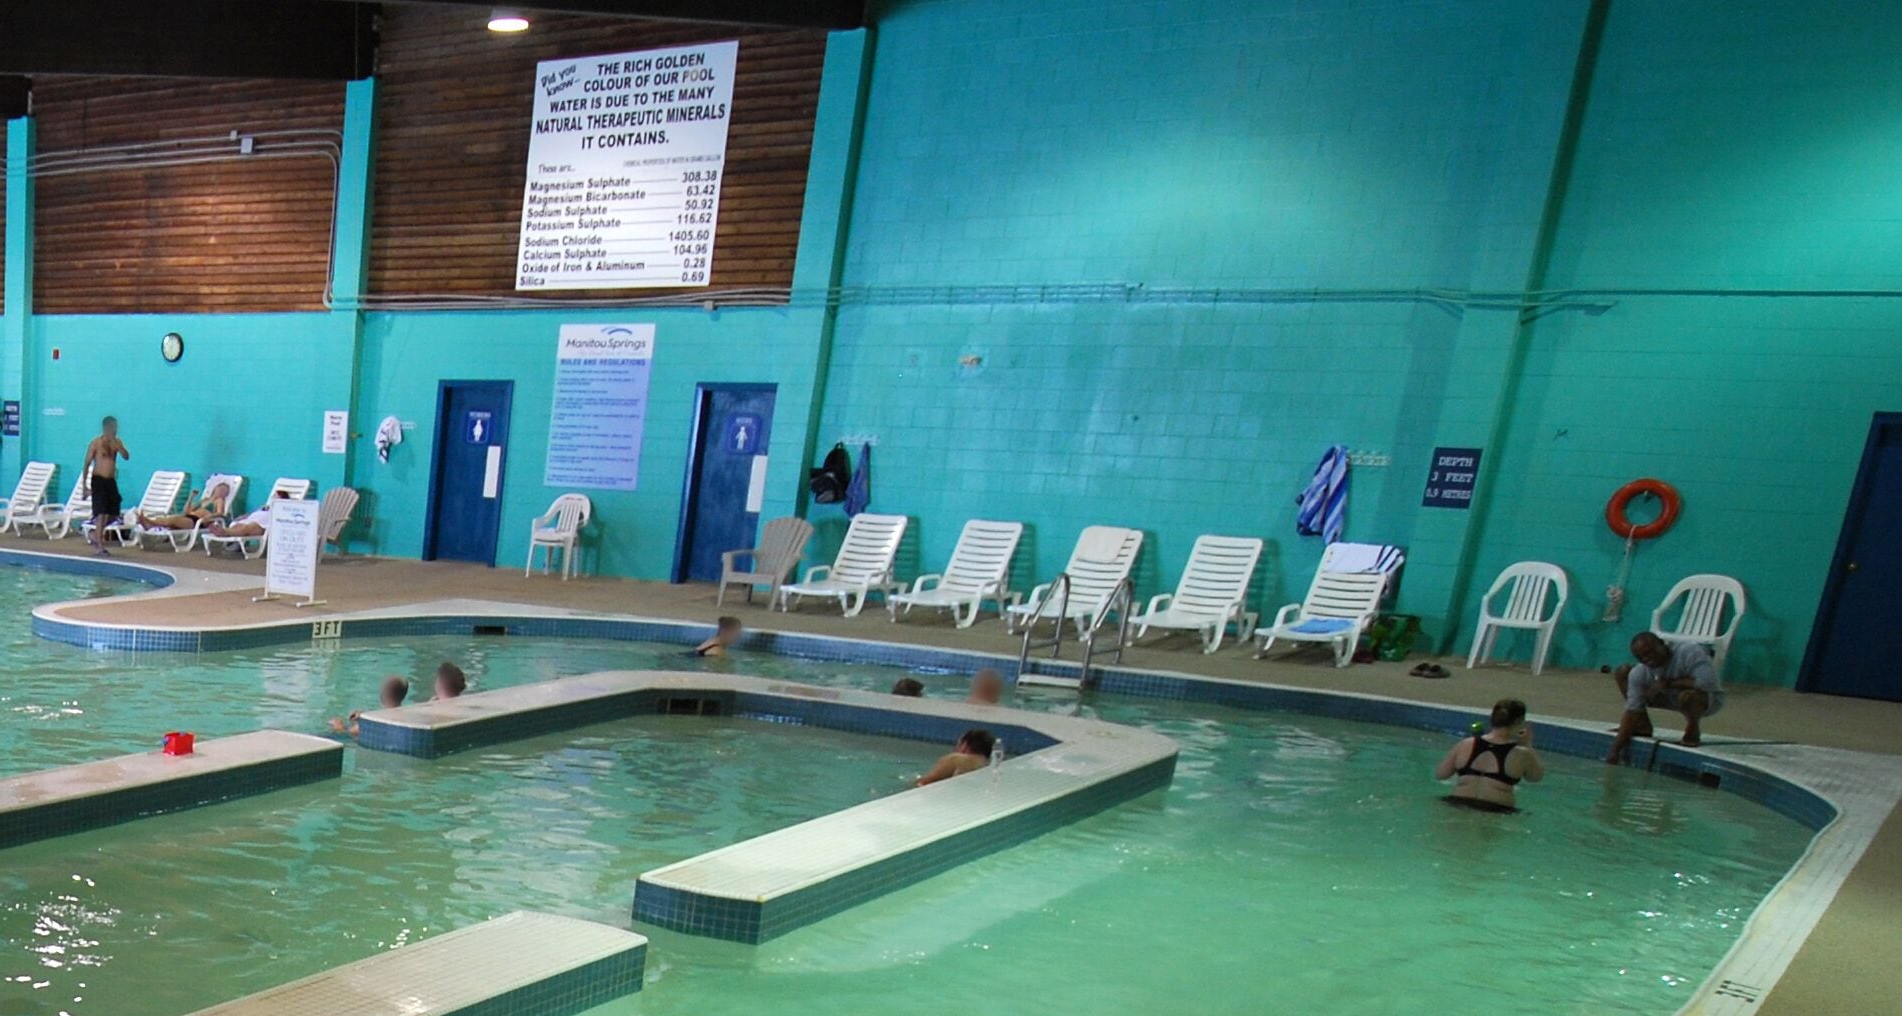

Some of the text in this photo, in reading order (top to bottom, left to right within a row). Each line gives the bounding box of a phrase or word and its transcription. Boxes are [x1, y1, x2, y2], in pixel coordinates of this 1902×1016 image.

[598, 52, 705, 76] THE RICH GOLDEN
[541, 64, 576, 88] Did you
[584, 68, 715, 93] COLOUR OF OUR POOL
[550, 86, 715, 113] WATER IS DUE TO THE MANY
[536, 103, 726, 134] NATURAL THERAPEUTIC MINERALS
[582, 130, 670, 150] IT CONTAINS.
[530, 170, 718, 193] Magnesium Sulphate 308.38
[528, 193, 582, 206] Magnesium
[586, 190, 646, 202] Bicarbonate
[527, 200, 714, 218] Sodium Sulphate 50.92
[526, 213, 712, 232] Potassium Sulphate 116.62
[525, 230, 710, 247] Sodium Chloride 1405.60
[523, 250, 561, 260] Calcium
[564, 248, 607, 260] Sulphate
[522, 258, 706, 274] Oxide of Iron & Aluminum 0.28
[520, 276, 545, 286] Silica
[566, 338, 646, 350] Manitou Springs
[1438, 456, 1474, 467] DEPTH
[1431, 472, 1474, 482] 3 FEET
